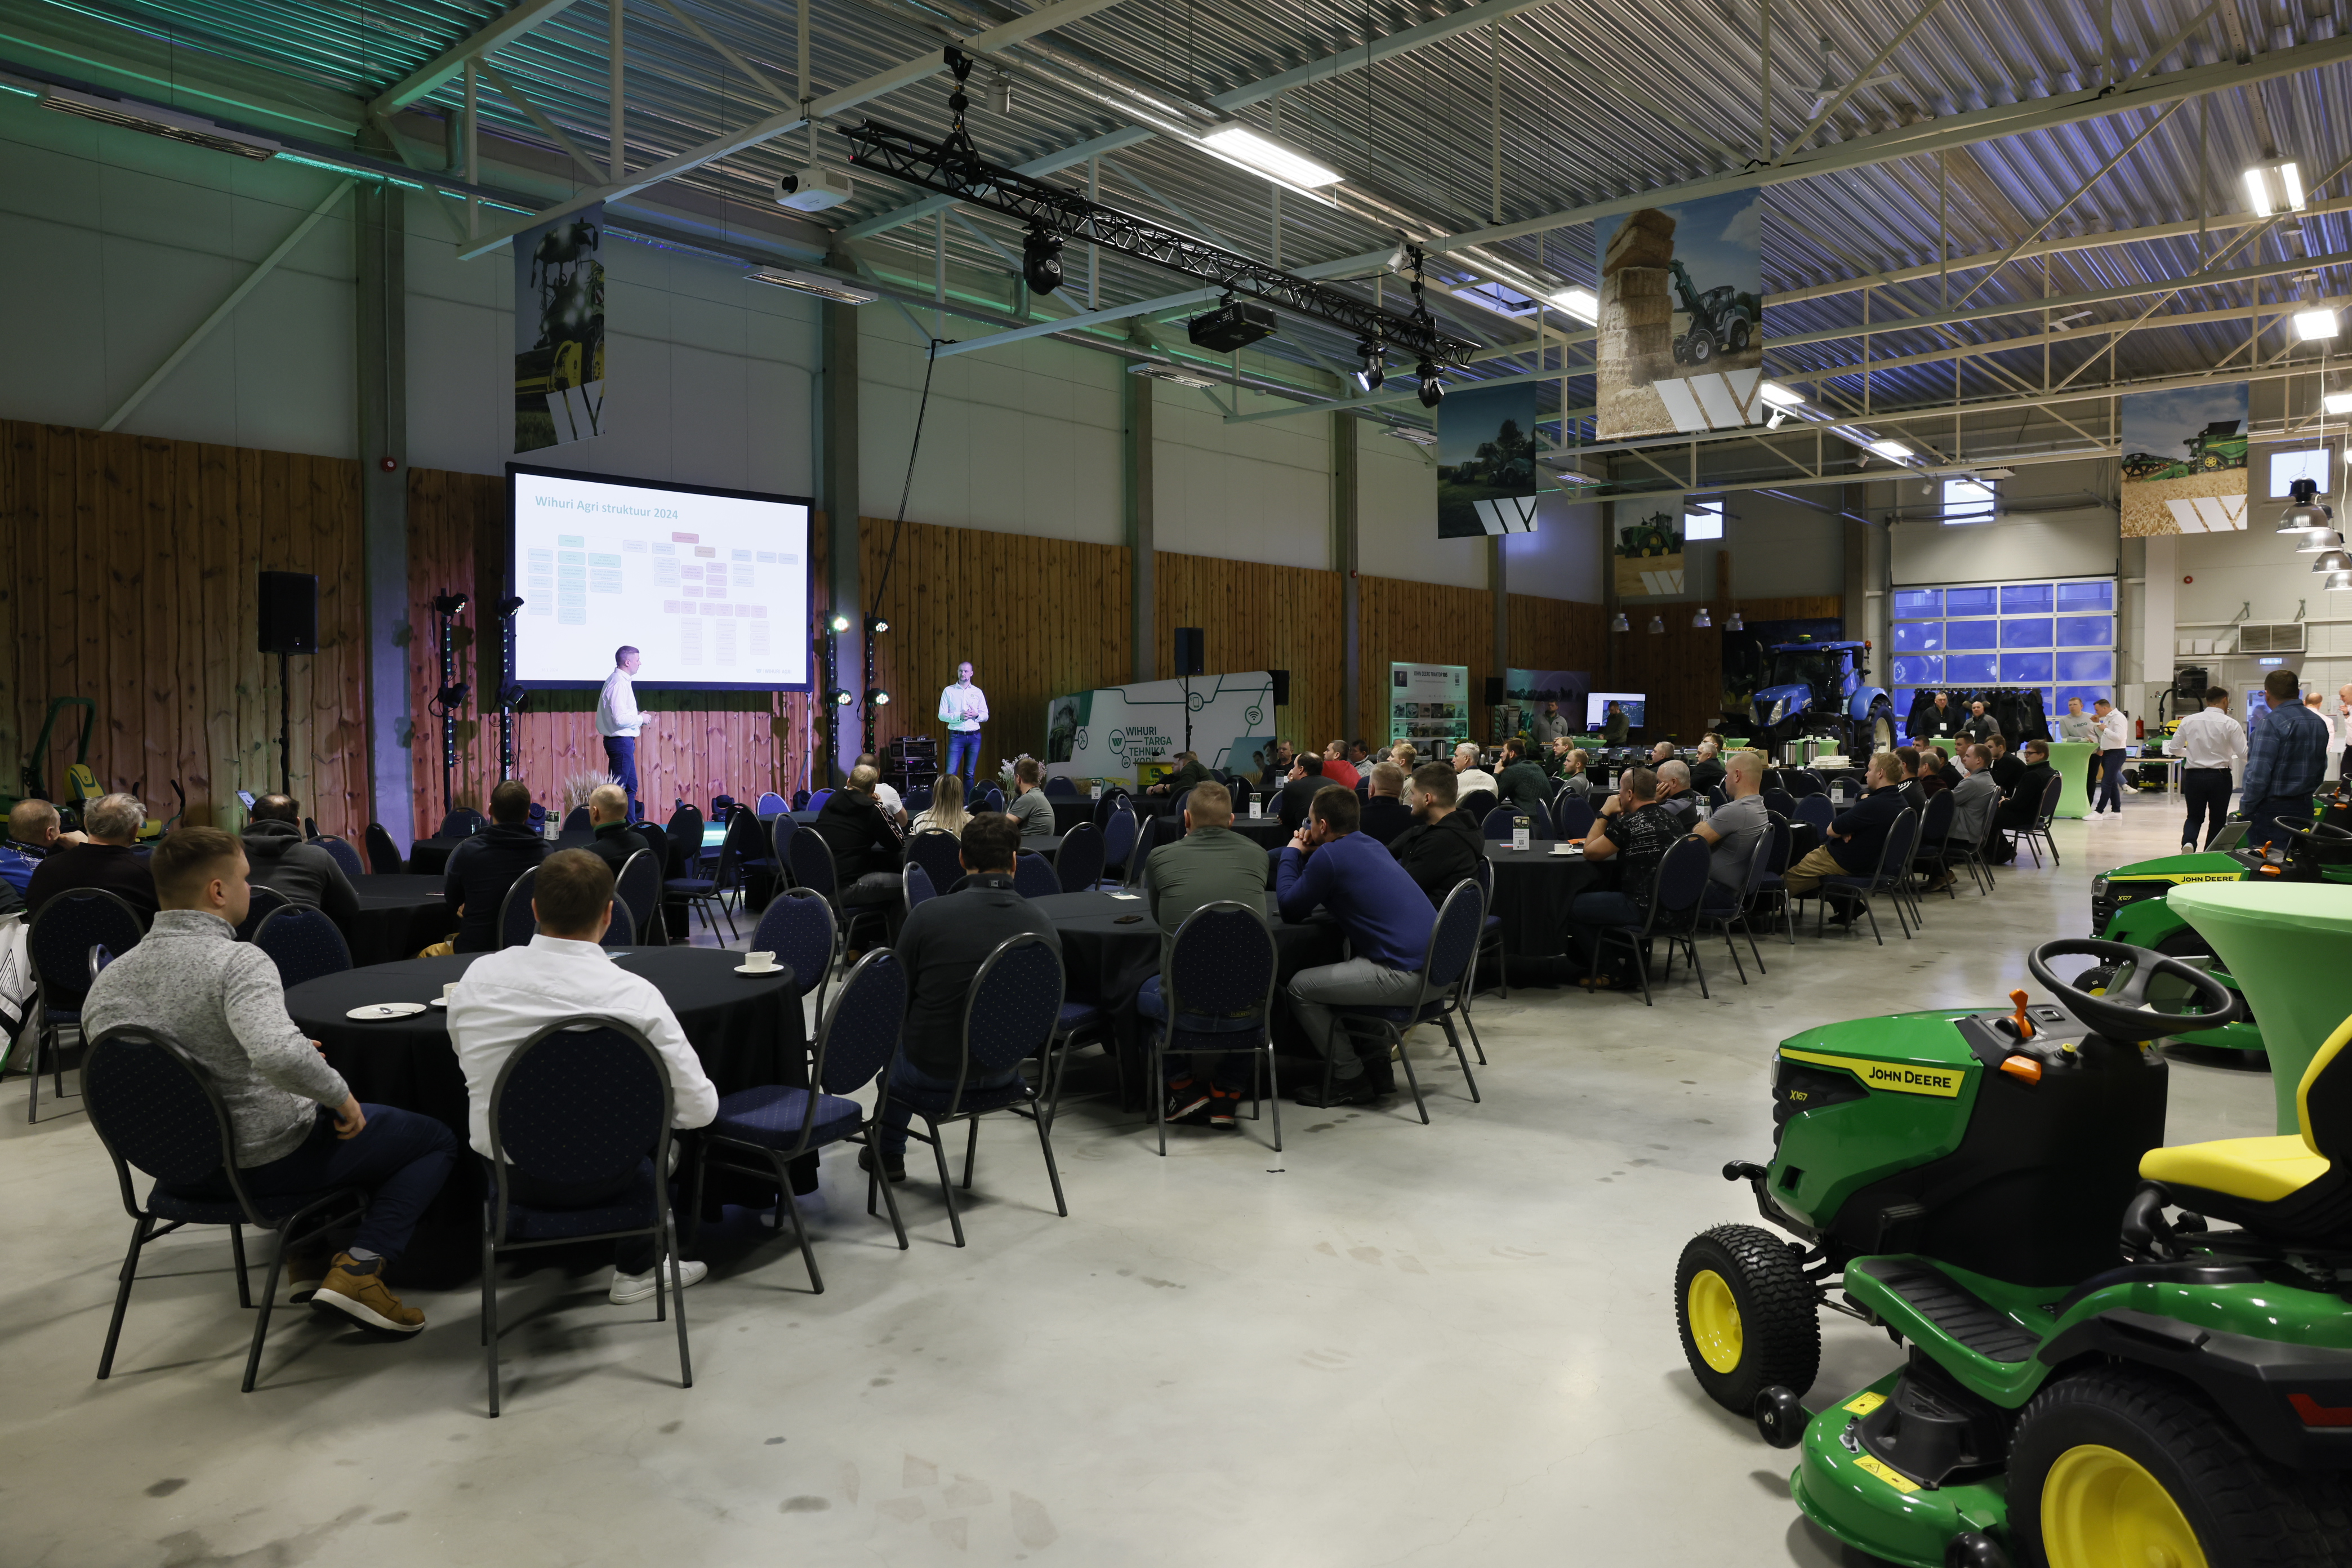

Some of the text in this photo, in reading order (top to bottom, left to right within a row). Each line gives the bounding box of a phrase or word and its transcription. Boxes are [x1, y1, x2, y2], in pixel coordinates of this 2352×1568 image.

[535, 495, 678, 519] Wihuri Agri struktuur 2024
[1125, 727, 1157, 736] WIHURI
[1144, 736, 1173, 746] TARGA
[1129, 747, 1166, 756] TEHNIKA
[1869, 1067, 1951, 1088] JOHN DEERE
[1789, 1090, 1807, 1101] X167
